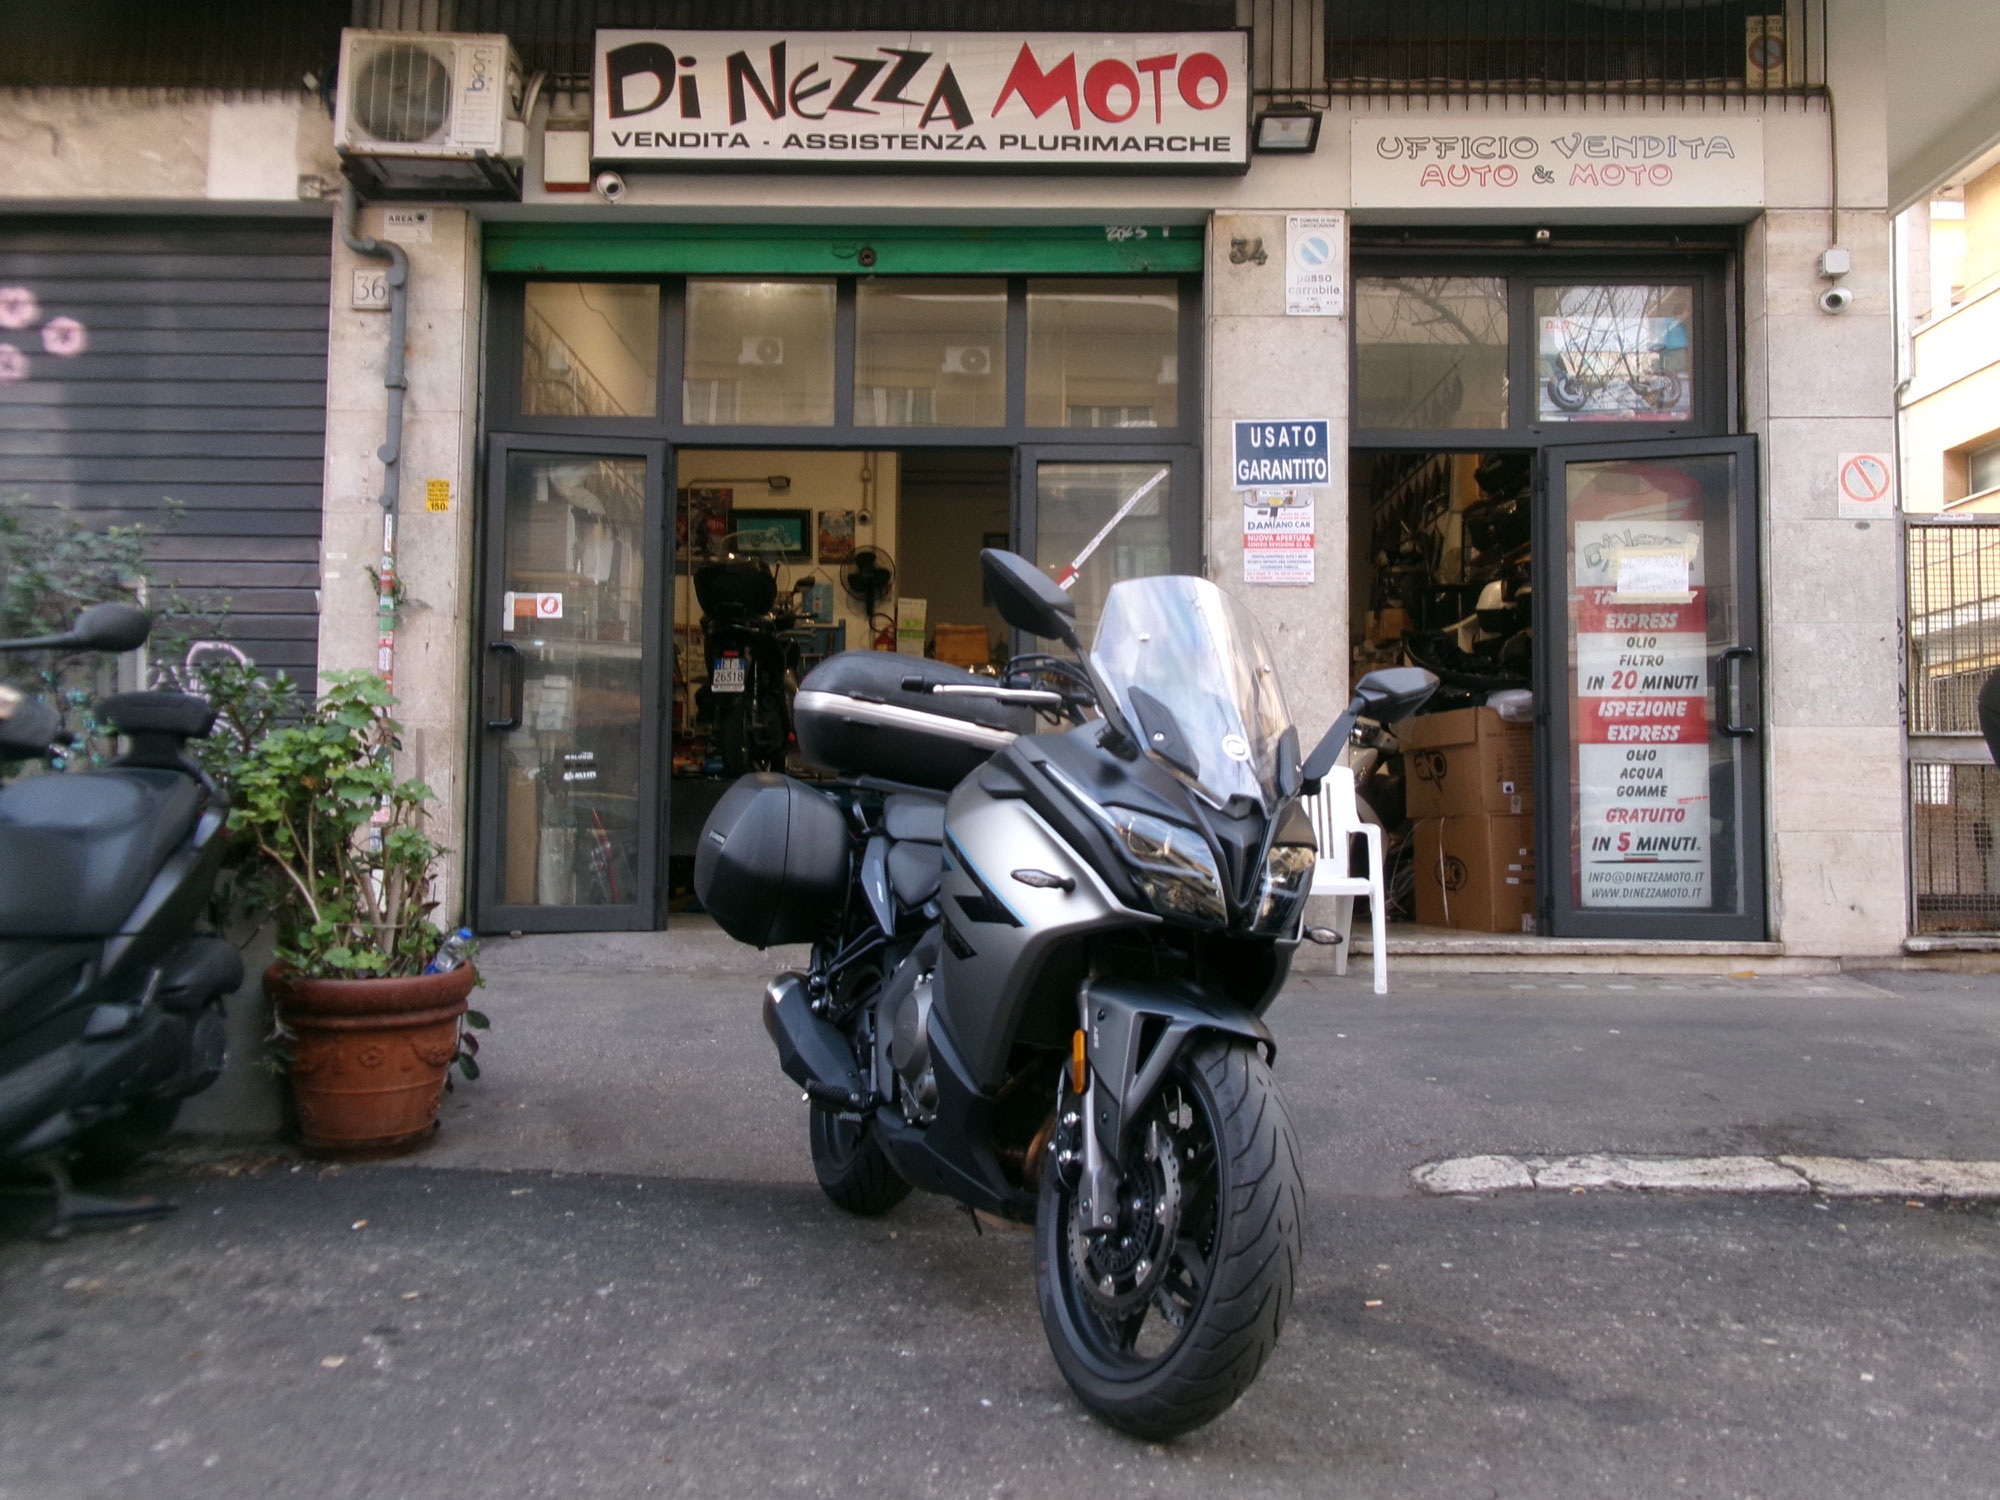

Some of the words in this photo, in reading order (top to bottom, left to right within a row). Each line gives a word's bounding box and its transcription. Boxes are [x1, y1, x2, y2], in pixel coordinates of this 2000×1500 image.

[992, 41, 1229, 131] MOTO
[611, 131, 750, 150] VENDITA
[782, 133, 987, 152] ASSISTENZA
[999, 134, 1231, 154] PLURIMARCHE
[1377, 136, 1539, 160] UFFICIO
[1550, 132, 1736, 160] VENDITA
[1420, 164, 1518, 187] AUTO
[1532, 165, 1555, 185] &
[1569, 163, 1673, 187] MOTO
[388, 215, 413, 223] AREA
[1297, 274, 1332, 285] passo
[356, 275, 386, 301] 36
[1288, 284, 1341, 296] carrabile
[1251, 425, 1316, 448] USATO
[1238, 458, 1327, 481] GARANTITO
[1247, 520, 1293, 531] DAMIANO
[1295, 520, 1311, 529] CAR
[1606, 613, 1678, 629] EXPRESS
[1627, 637, 1657, 648] OLIO
[1619, 655, 1664, 667] FILTRO
[1586, 676, 1604, 690] IN
[1611, 669, 1638, 690] 20
[1642, 675, 1699, 690] MINUTI
[1598, 701, 1688, 717] ISPEZIONE
[1607, 725, 1681, 742] EXPRESS
[1626, 750, 1657, 761] OLIO
[1620, 768, 1663, 780] ACQUA
[1616, 786, 1668, 797] GOMME
[1606, 808, 1686, 823] GRATUITO
[1592, 837, 1611, 851] IN
[1616, 832, 1631, 851] 5
[1588, 872, 1704, 883] INFO@DINEZZAMOTO.IT
[1591, 888, 1702, 898] WWW.DINEZZAMOTO.IT
